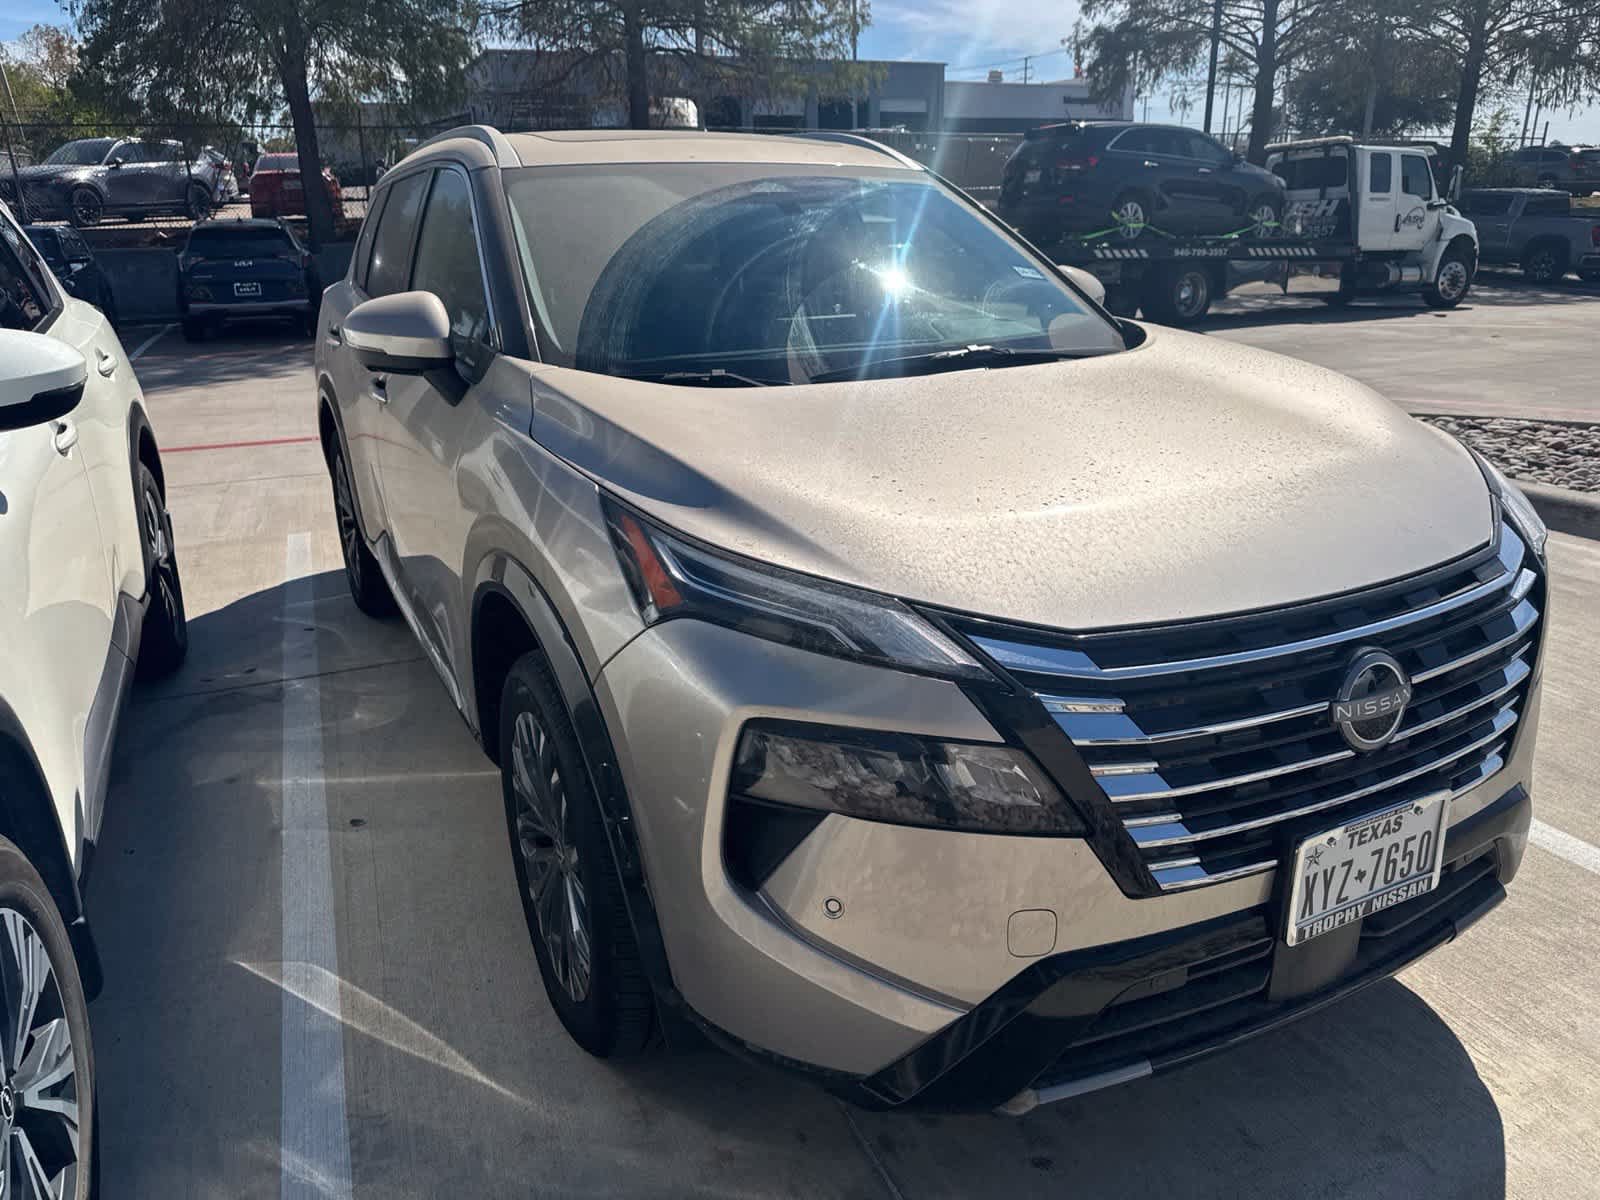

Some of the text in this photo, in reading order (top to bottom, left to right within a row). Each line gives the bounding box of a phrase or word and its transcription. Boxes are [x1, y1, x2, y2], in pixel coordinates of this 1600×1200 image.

[1347, 814, 1404, 850] TEXAS
[1300, 830, 1432, 919] XYZ 7650
[1302, 878, 1430, 940] TROPHY NISSAN
